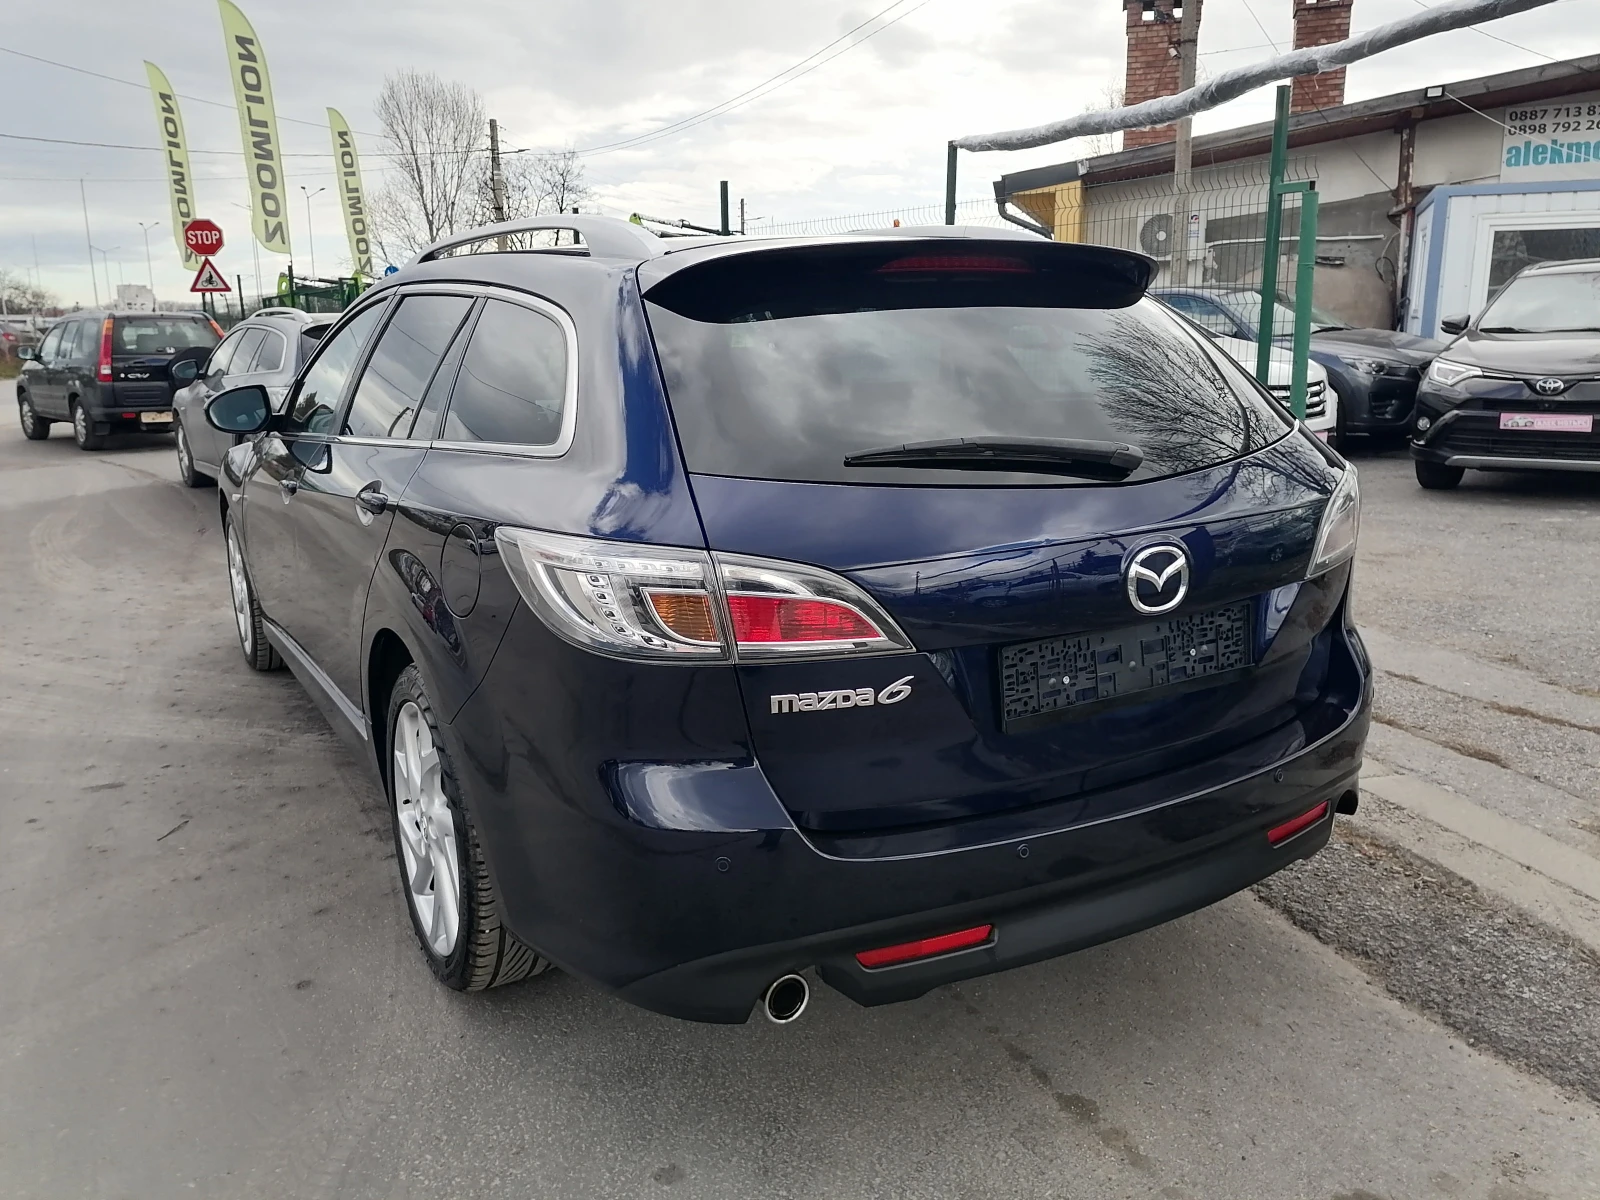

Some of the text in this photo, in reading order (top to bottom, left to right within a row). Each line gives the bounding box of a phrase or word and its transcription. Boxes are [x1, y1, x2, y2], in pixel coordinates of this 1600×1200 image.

[1509, 105, 1600, 121] 0887 713 8
[1508, 123, 1547, 136] 0898
[1552, 121, 1581, 133] 792
[187, 230, 220, 245] STOP
[877, 675, 915, 706] 6
